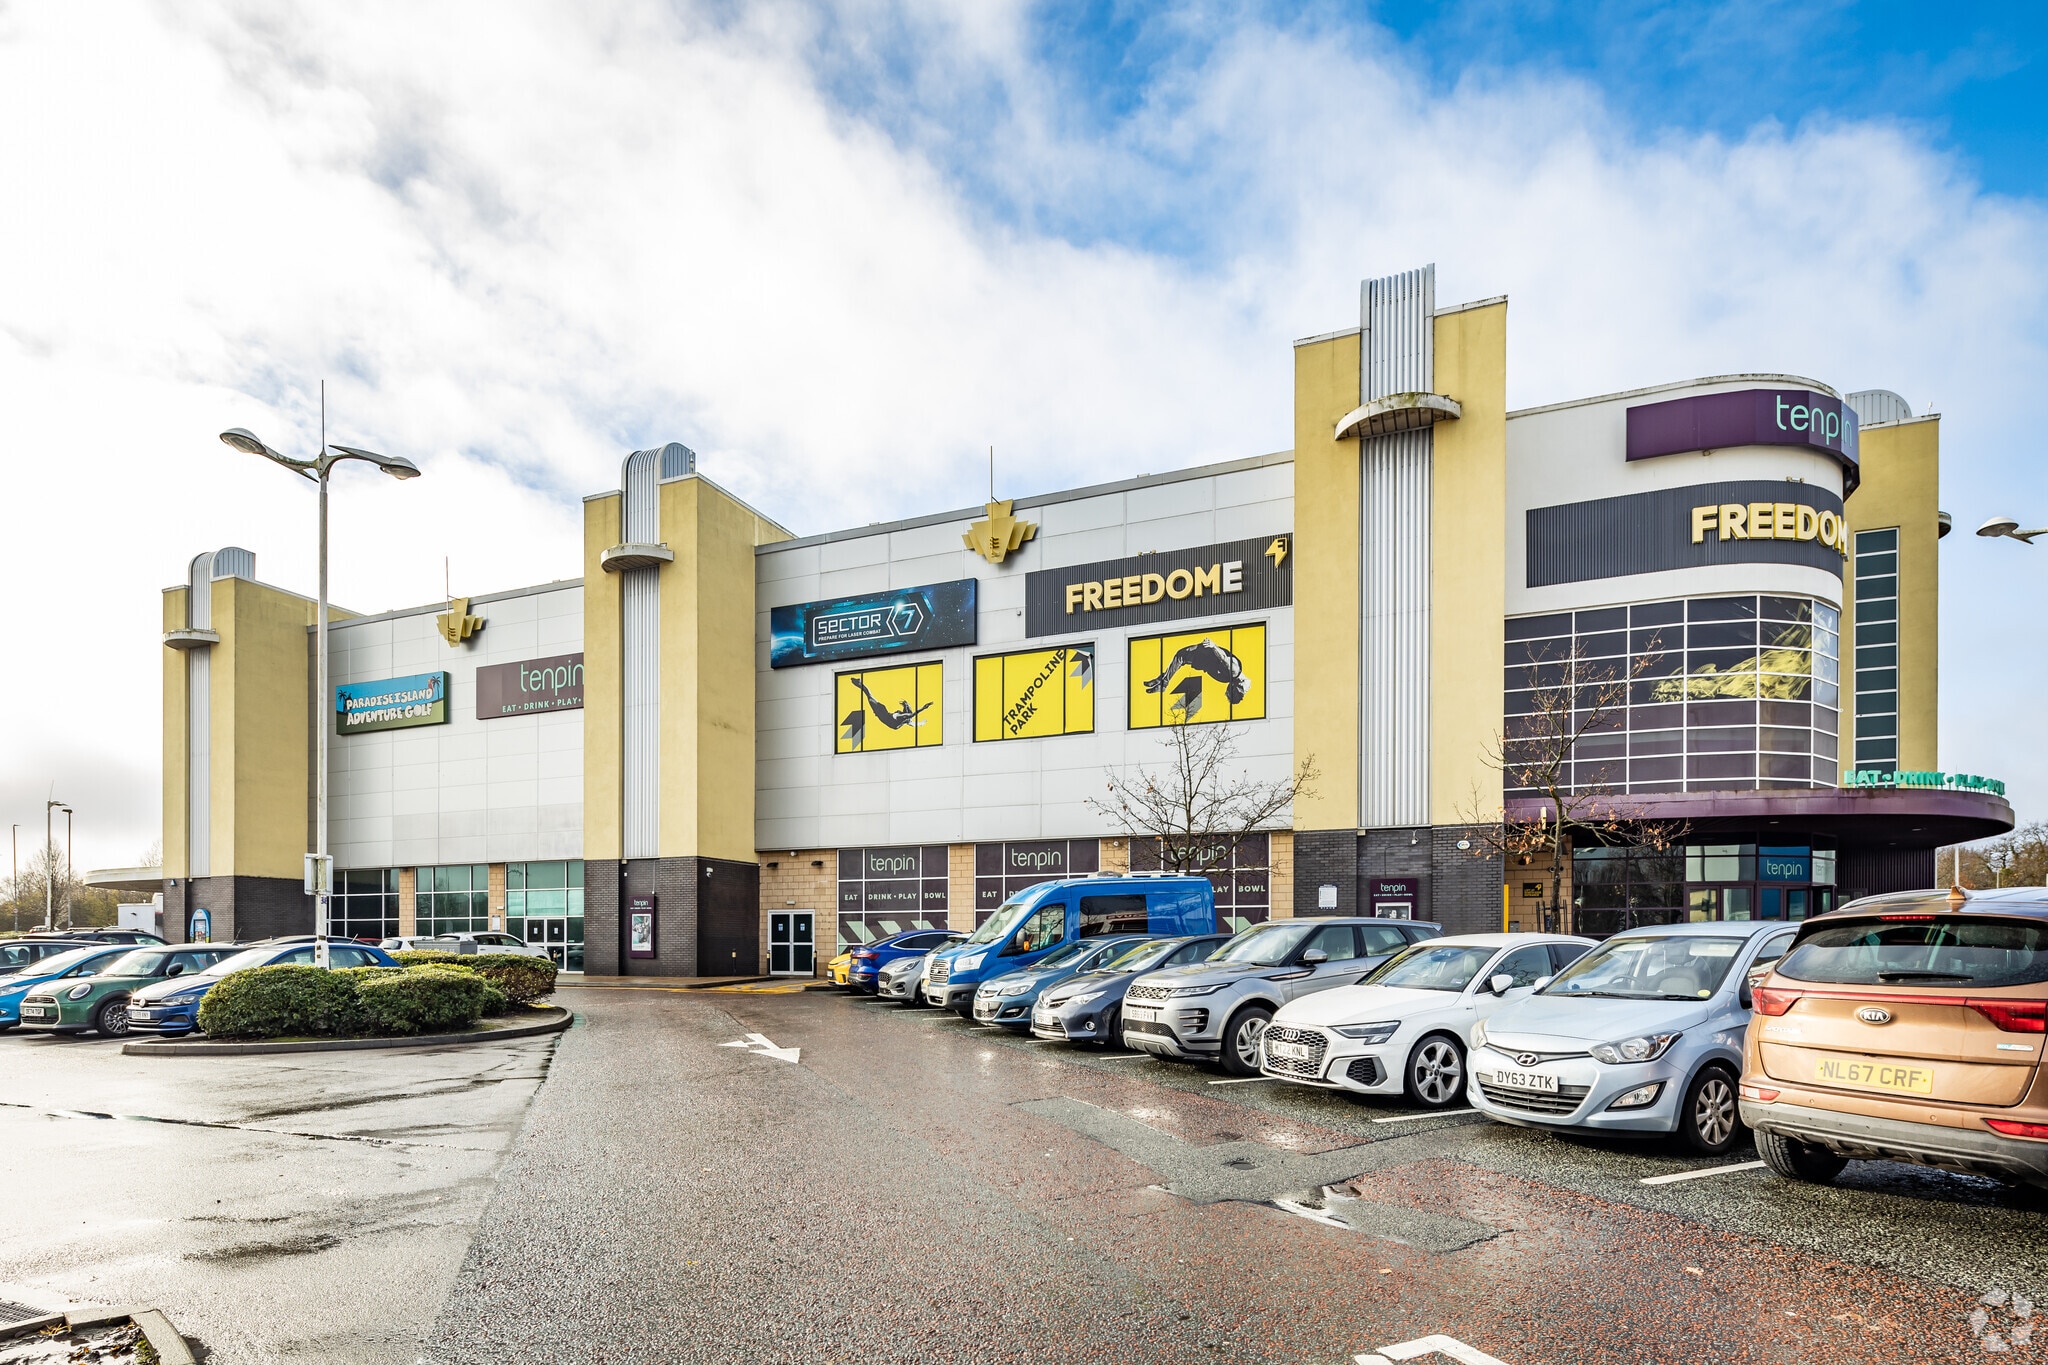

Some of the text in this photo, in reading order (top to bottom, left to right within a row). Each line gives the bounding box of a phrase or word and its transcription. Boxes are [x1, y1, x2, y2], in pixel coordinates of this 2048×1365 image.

[1776, 394, 1852, 448] tenpin
[1066, 560, 1243, 615] FREEDOME
[818, 609, 916, 635] SECTOR 7
[520, 659, 584, 697] tenpin
[1002, 649, 1065, 726] TRAMPOLINE
[346, 688, 433, 710] PARADISE ISLAND
[502, 697, 578, 713] EAT DRINK PLAY
[346, 702, 433, 726] ADVENTURE GOLF
[1010, 702, 1038, 735] PARK
[1844, 770, 1882, 785] EAT
[1893, 771, 1946, 786] DRINK
[870, 853, 915, 876] tenpin
[1011, 848, 1062, 871] tenpin
[1766, 859, 1802, 878] tenpin
[982, 890, 998, 898] EAT
[1212, 885, 1229, 893] LAY
[1380, 883, 1406, 893] tenpin
[1863, 1010, 1884, 1021] KIA
[1497, 1070, 1553, 1089] DY63 ZTK
[1823, 1061, 1923, 1087] NL67 CRF
